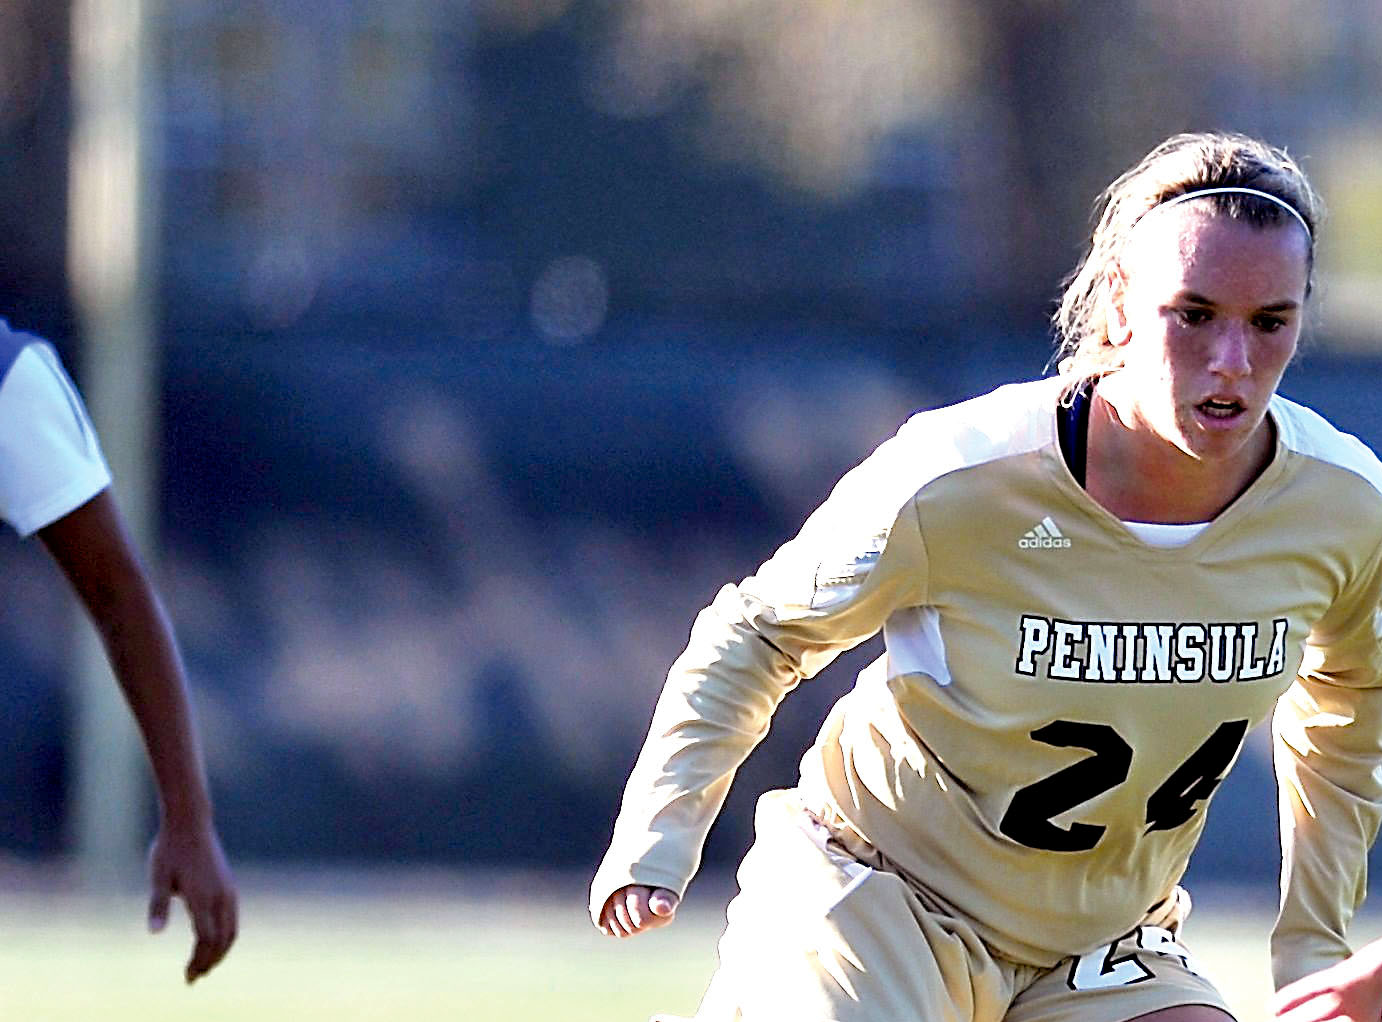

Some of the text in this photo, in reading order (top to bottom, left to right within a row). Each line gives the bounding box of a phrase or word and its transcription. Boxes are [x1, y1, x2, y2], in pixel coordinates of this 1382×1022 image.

[1018, 536, 1071, 549] adidas
[1015, 614, 1289, 684] PENINSULA
[999, 719, 1250, 852] 24
